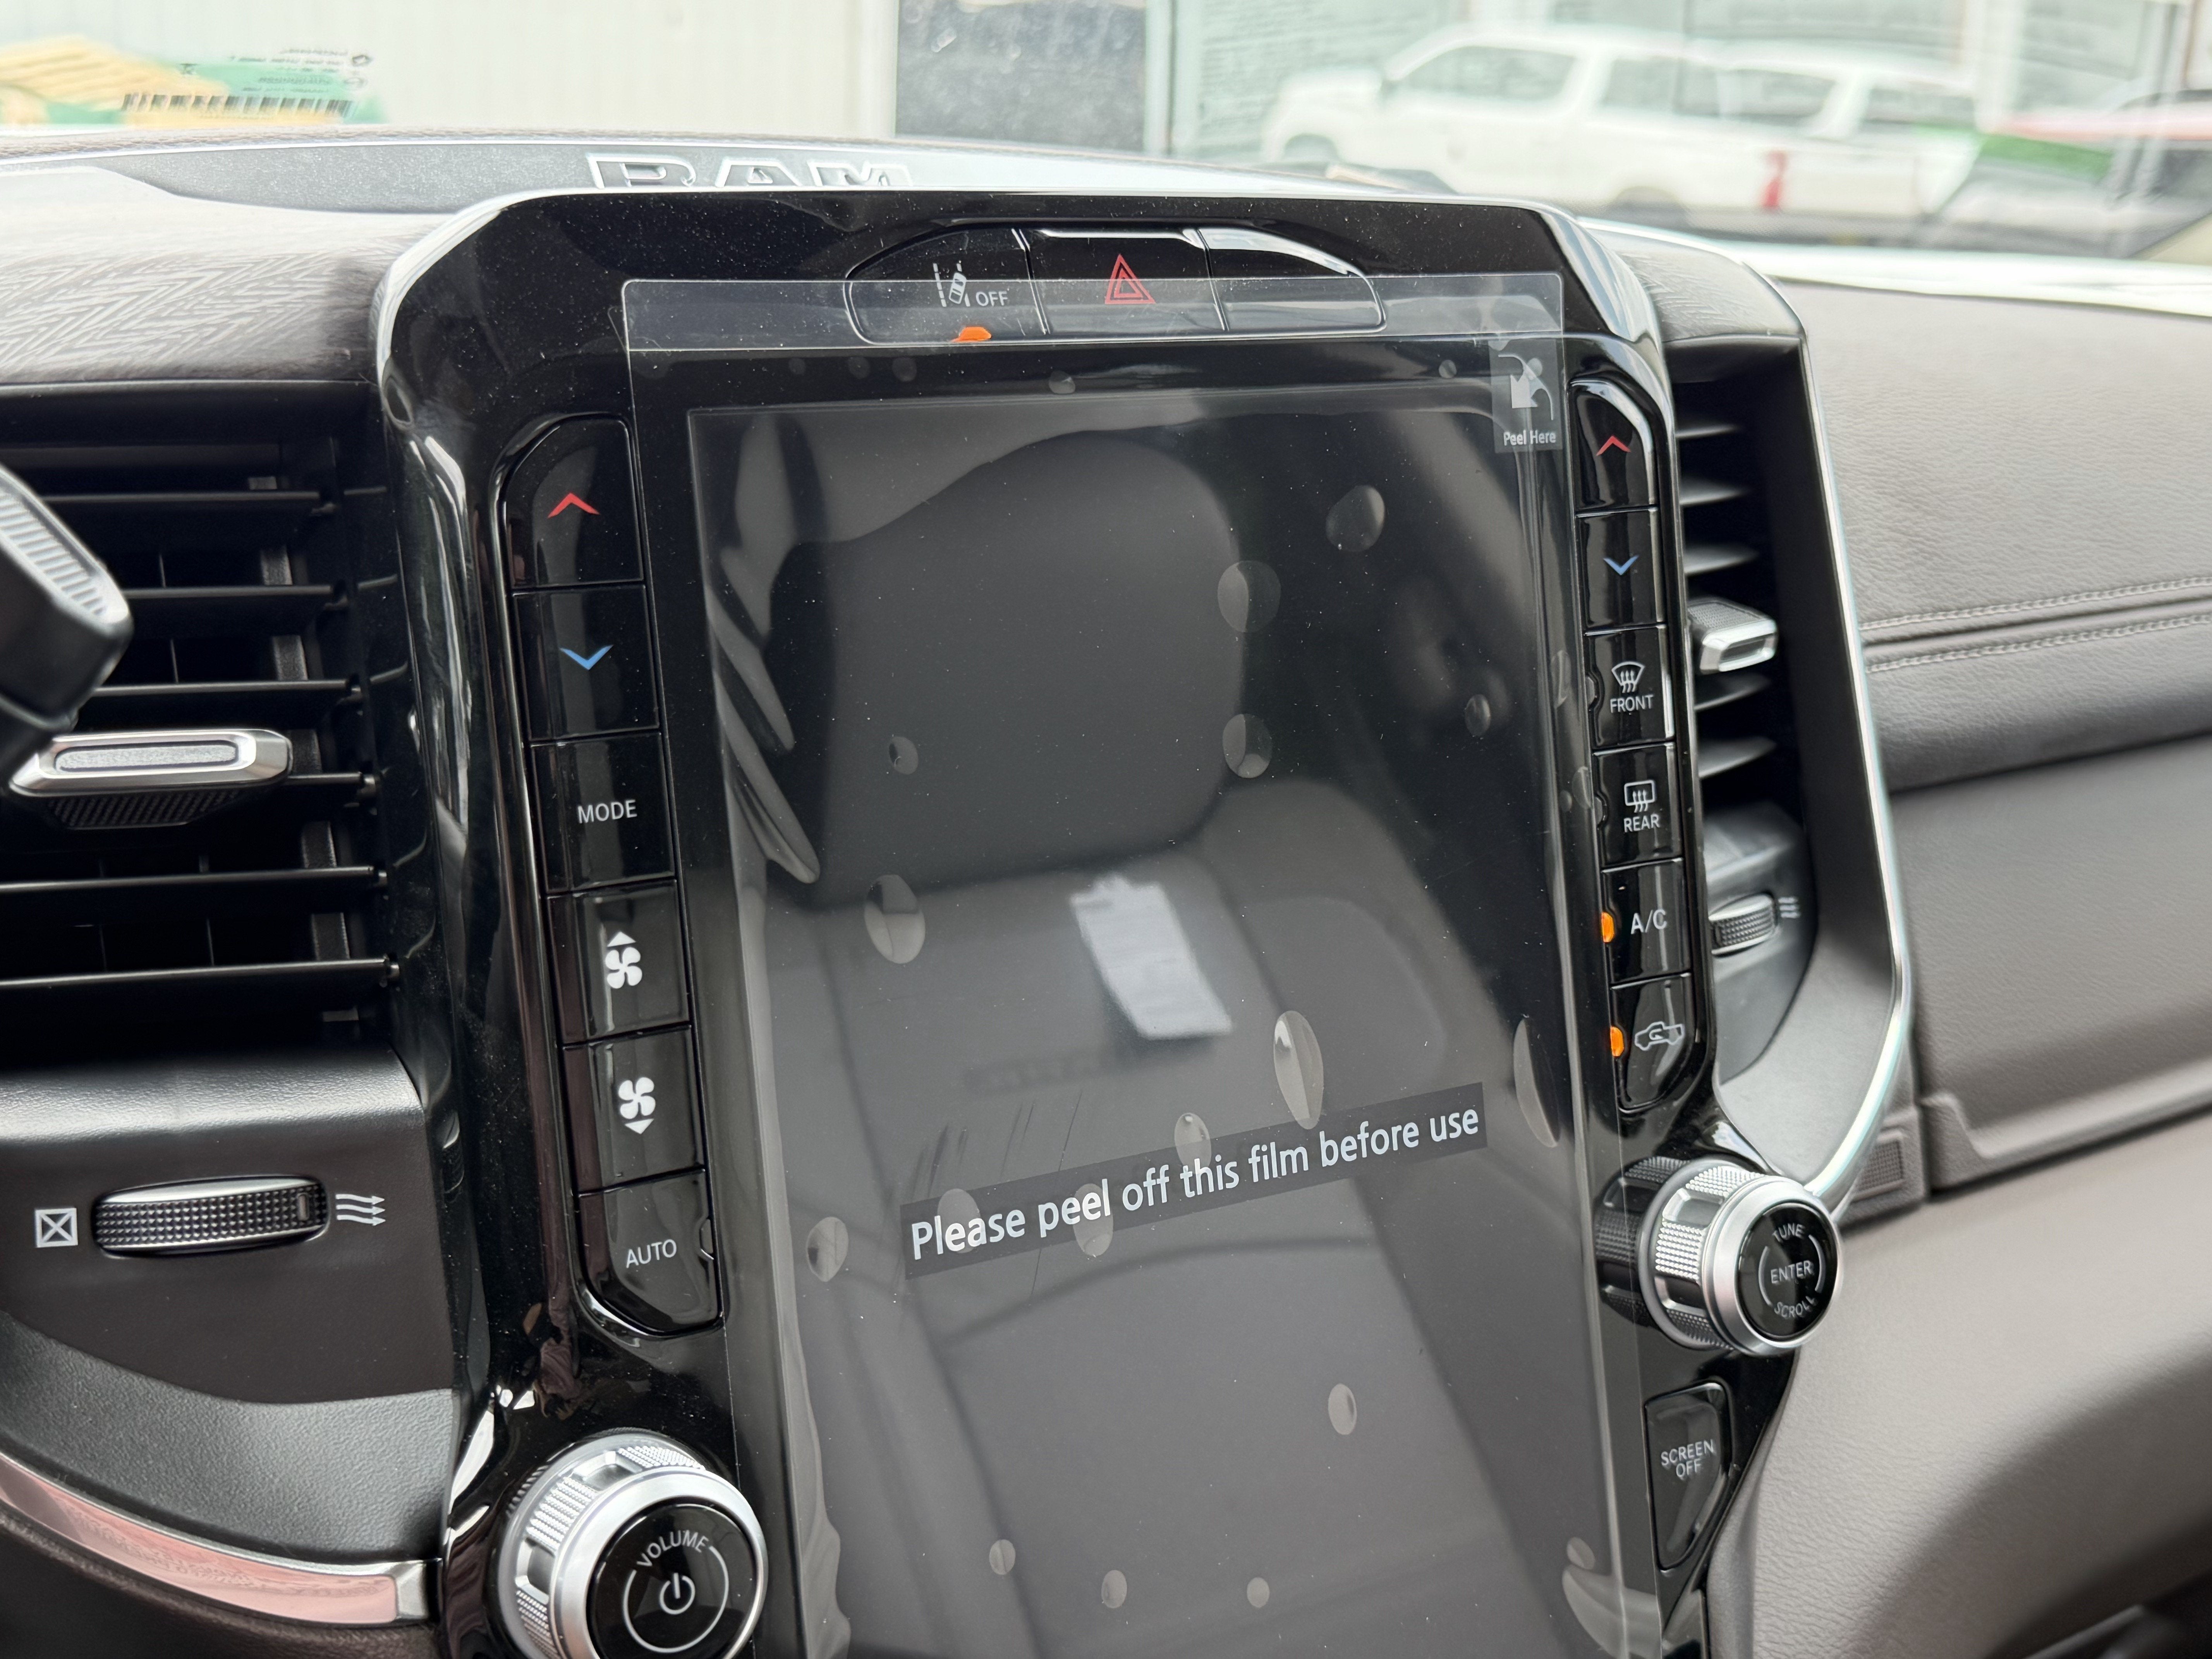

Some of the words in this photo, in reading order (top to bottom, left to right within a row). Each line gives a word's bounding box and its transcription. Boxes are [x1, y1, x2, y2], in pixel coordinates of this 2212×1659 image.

[587, 153, 914, 187] RAM
[975, 291, 1008, 307] OFF
[1503, 430, 1527, 446] Peel
[1530, 429, 1556, 444] Here
[1610, 694, 1653, 713] FRONT
[577, 800, 637, 823] MODE
[1624, 814, 1660, 832] REAR
[1631, 909, 1667, 934] A/C
[911, 1209, 1025, 1260] Please
[1038, 1179, 1110, 1238] peel
[1122, 1165, 1170, 1211] off
[1180, 1154, 1240, 1198] this
[1248, 1142, 1308, 1183] film
[1320, 1120, 1420, 1167] before
[1429, 1109, 1479, 1141] use
[1772, 1223, 1805, 1242] TUNE
[626, 1239, 677, 1268] AUTO
[1771, 1260, 1814, 1285] ENTER
[1774, 1295, 1818, 1318] SCROLL
[1661, 1439, 1715, 1468] SCREEN
[1676, 1459, 1702, 1478] OFF
[637, 1530, 709, 1568] VOLUME
